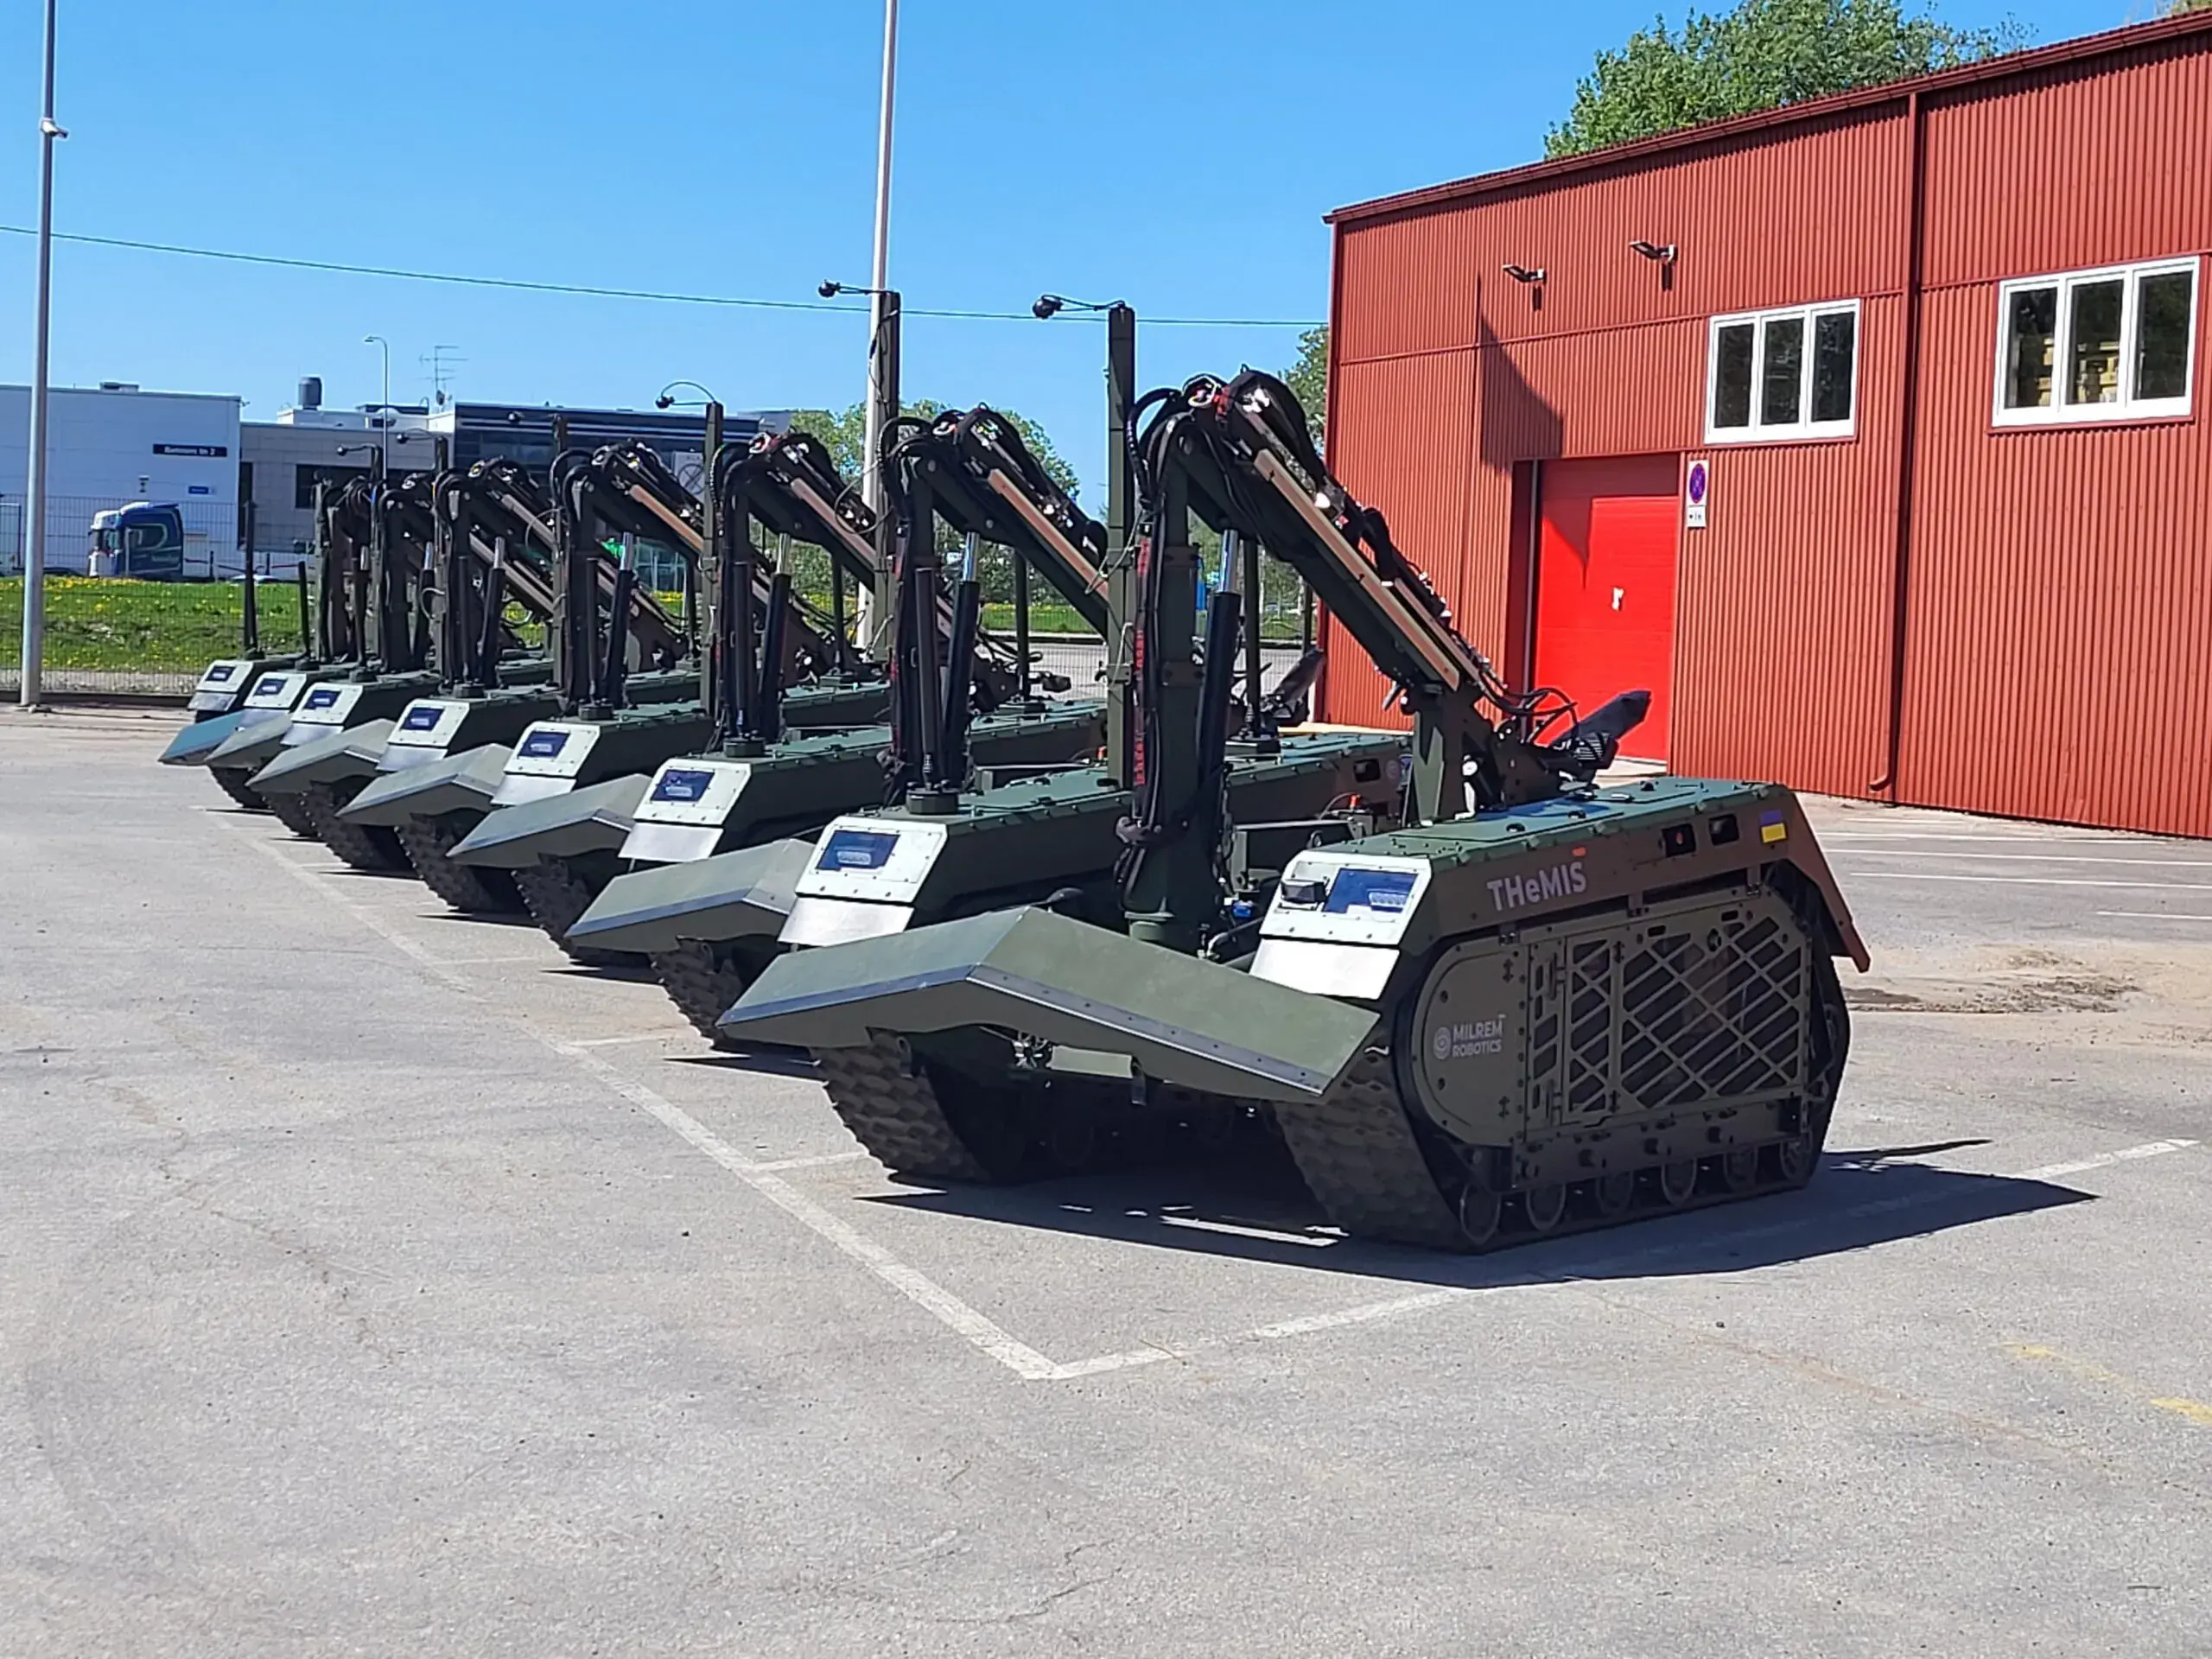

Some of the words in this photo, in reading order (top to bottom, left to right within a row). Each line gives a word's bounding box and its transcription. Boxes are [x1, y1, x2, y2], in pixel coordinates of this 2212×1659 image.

[1487, 861, 1586, 911] THeMIS
[1452, 1020, 1503, 1043] MILREM
[1452, 1039, 1502, 1058] ROBOTICS
